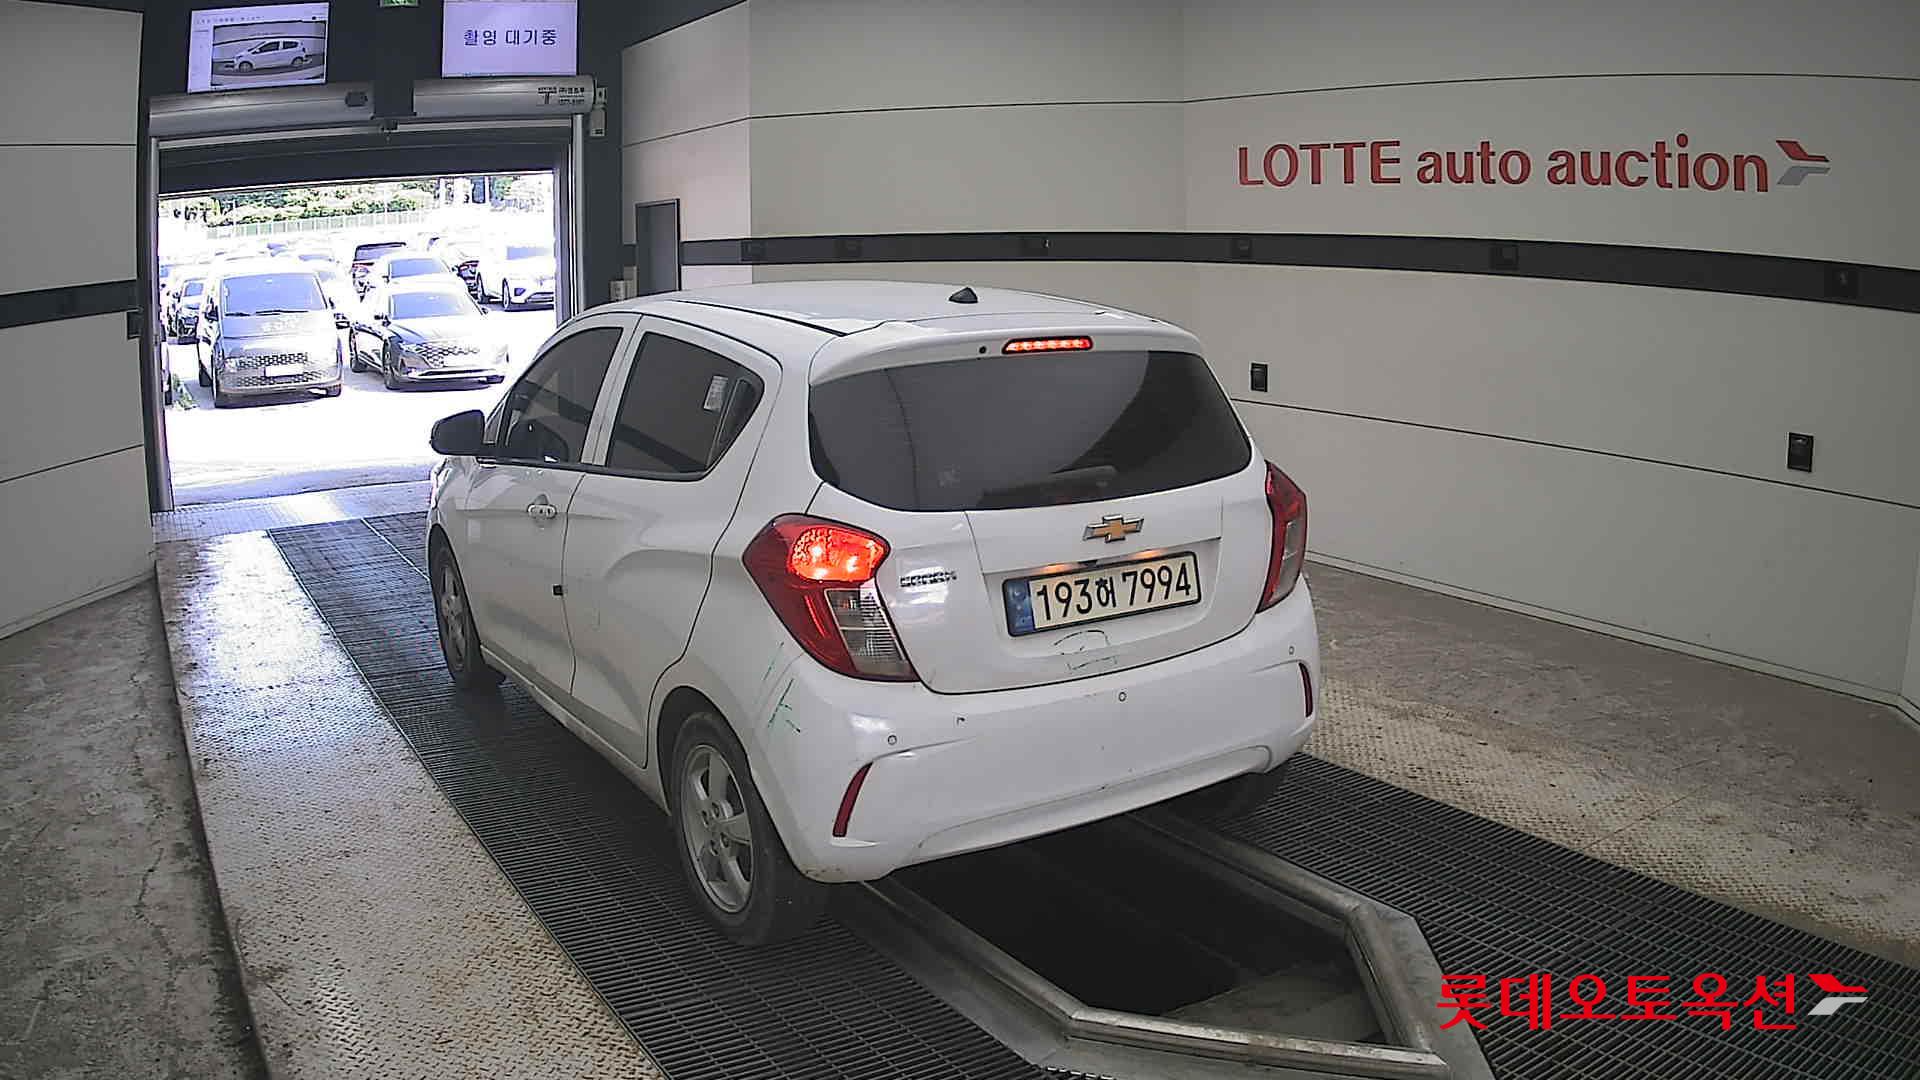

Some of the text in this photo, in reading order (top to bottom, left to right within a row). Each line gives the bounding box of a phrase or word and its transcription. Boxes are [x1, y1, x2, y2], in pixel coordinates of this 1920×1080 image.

[505, 29, 557, 46] 대기중
[1238, 133, 1769, 193] LOTTE auto auction
